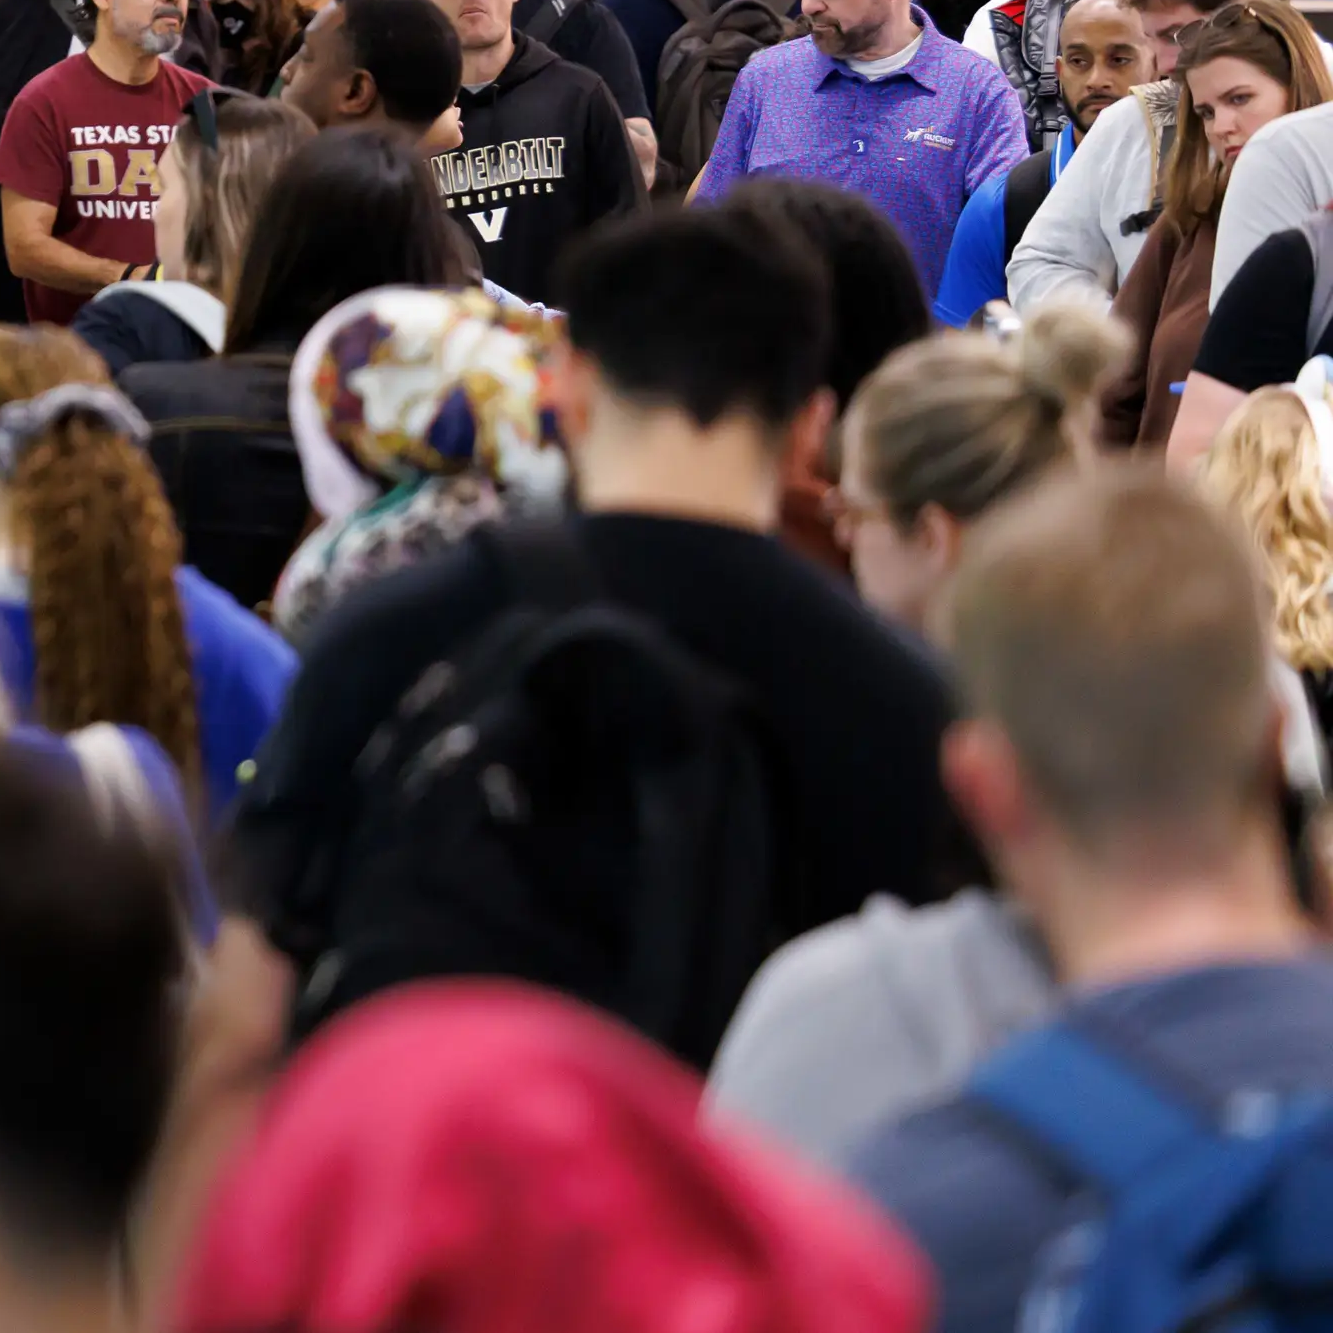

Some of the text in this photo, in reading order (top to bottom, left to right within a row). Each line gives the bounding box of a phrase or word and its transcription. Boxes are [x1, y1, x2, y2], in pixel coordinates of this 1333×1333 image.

[70, 125, 141, 145] TEXAS
[68, 149, 162, 196] DA
[431, 137, 565, 195] NDERBILT
[446, 182, 551, 208] MMODORES
